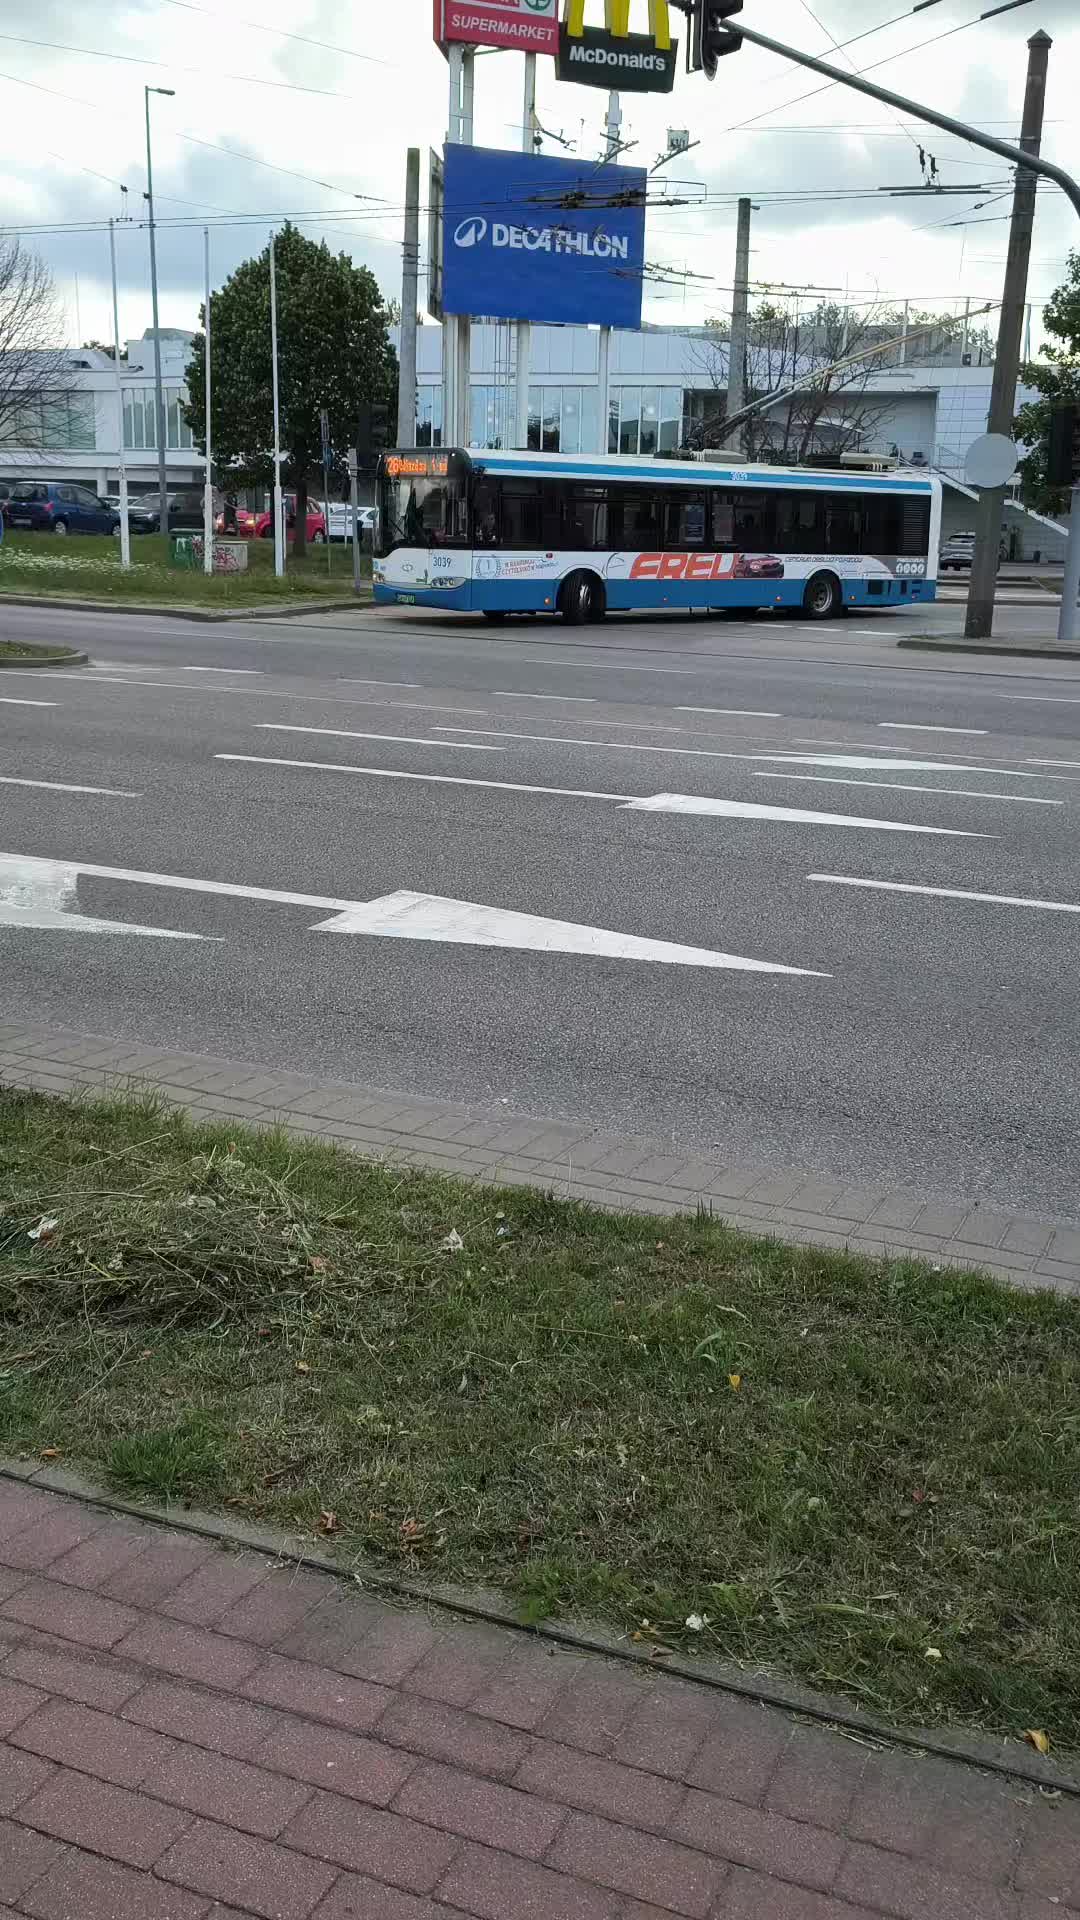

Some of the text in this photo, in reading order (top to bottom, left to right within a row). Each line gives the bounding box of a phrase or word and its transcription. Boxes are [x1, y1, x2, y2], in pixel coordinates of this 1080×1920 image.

[451, 14, 555, 41] SUPERMARKET
[569, 45, 666, 71] McDonald's
[492, 223, 628, 259] DECATHLON
[432, 556, 452, 568] 3039
